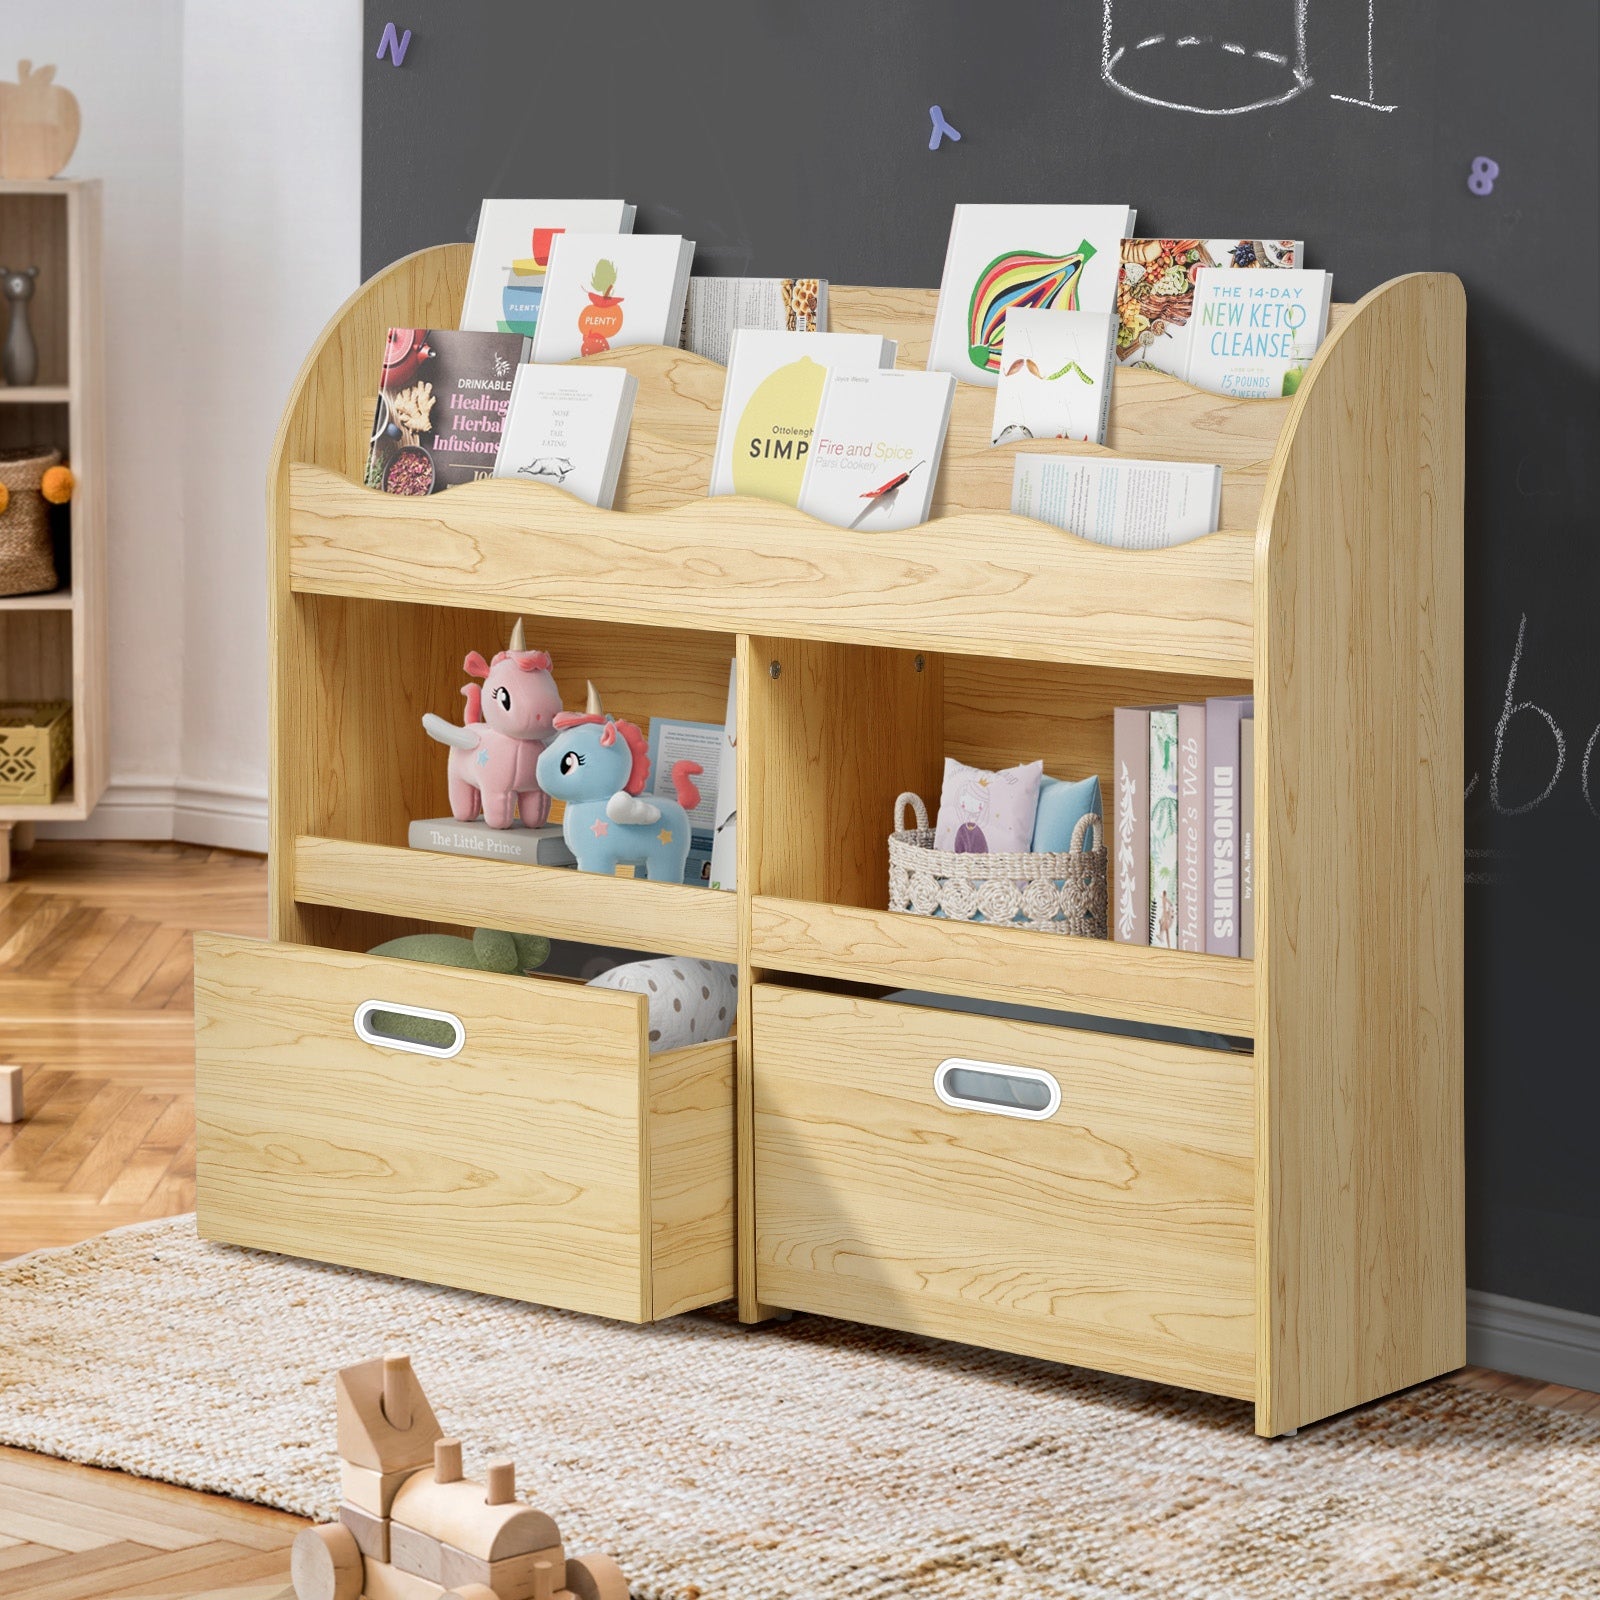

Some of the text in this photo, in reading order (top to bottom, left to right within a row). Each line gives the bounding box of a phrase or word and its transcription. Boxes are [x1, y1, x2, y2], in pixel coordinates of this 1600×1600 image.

[376, 22, 412, 67] N
[1467, 156, 1499, 196] 8
[1213, 286, 1303, 299] THE 14-DAY
[585, 316, 617, 326] PLENTY
[1202, 302, 1307, 329] NEW KETO
[1210, 331, 1291, 358] CLEANSE
[457, 378, 513, 391] DRINKABLE
[1235, 376, 1271, 388] POUNDS
[450, 393, 511, 416] Healing
[452, 415, 507, 433] Herbal
[432, 434, 501, 454] Infusions
[818, 439, 914, 462] Fire and Spice
[1182, 737, 1198, 797] Web
[430, 830, 523, 857] The Little Prince
[1213, 766, 1234, 939] DINOSAURS
